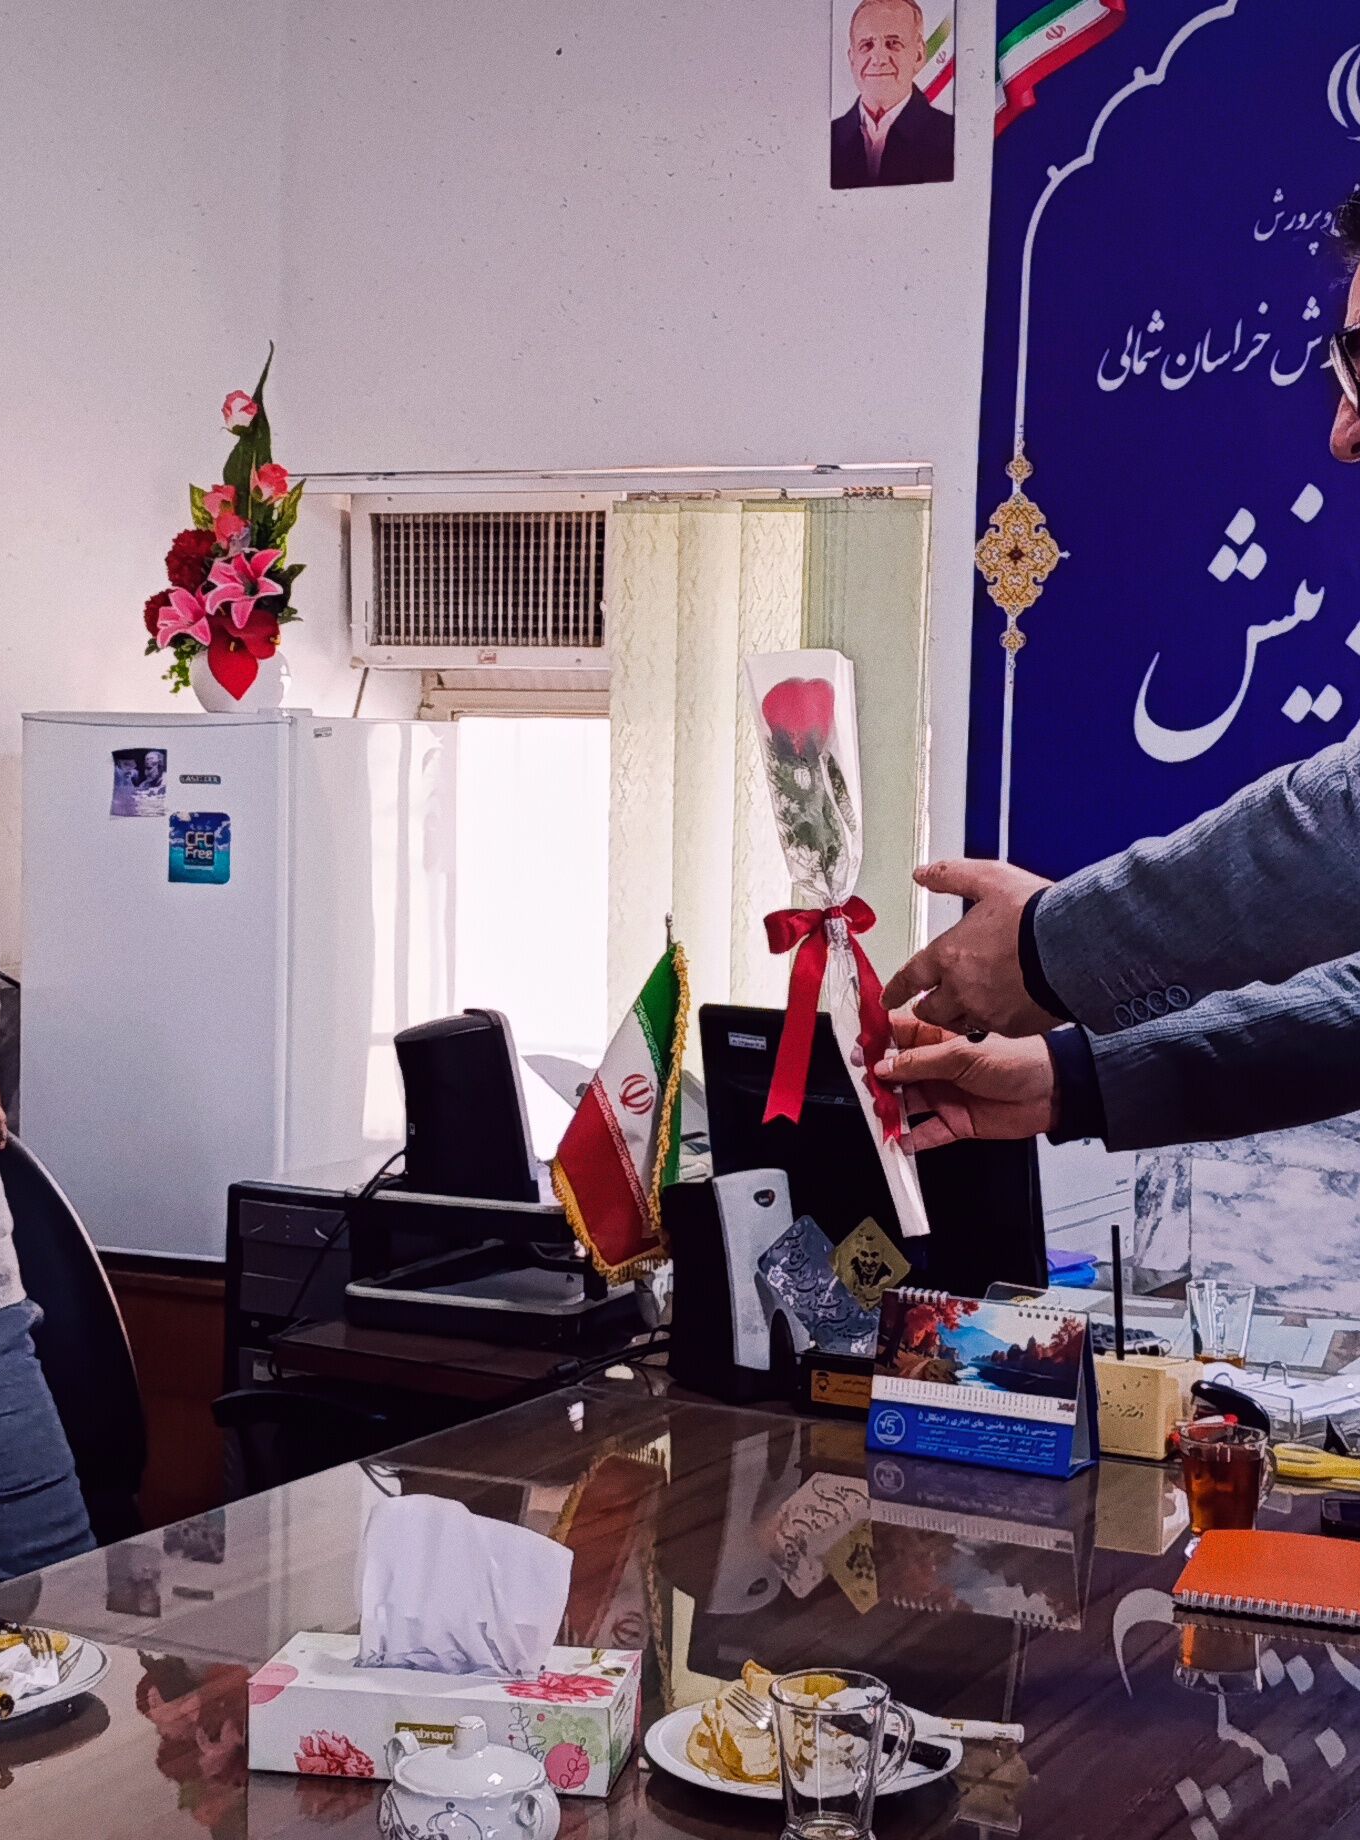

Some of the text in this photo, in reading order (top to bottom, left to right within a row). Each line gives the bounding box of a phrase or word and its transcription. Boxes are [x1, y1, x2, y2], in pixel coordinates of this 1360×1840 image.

[1253, 188, 1322, 256] پرورش
[1096, 308, 1166, 392] شمالی
[1160, 301, 1272, 391] خراسان
[185, 831, 214, 848] CFC
[185, 847, 213, 859] Free
